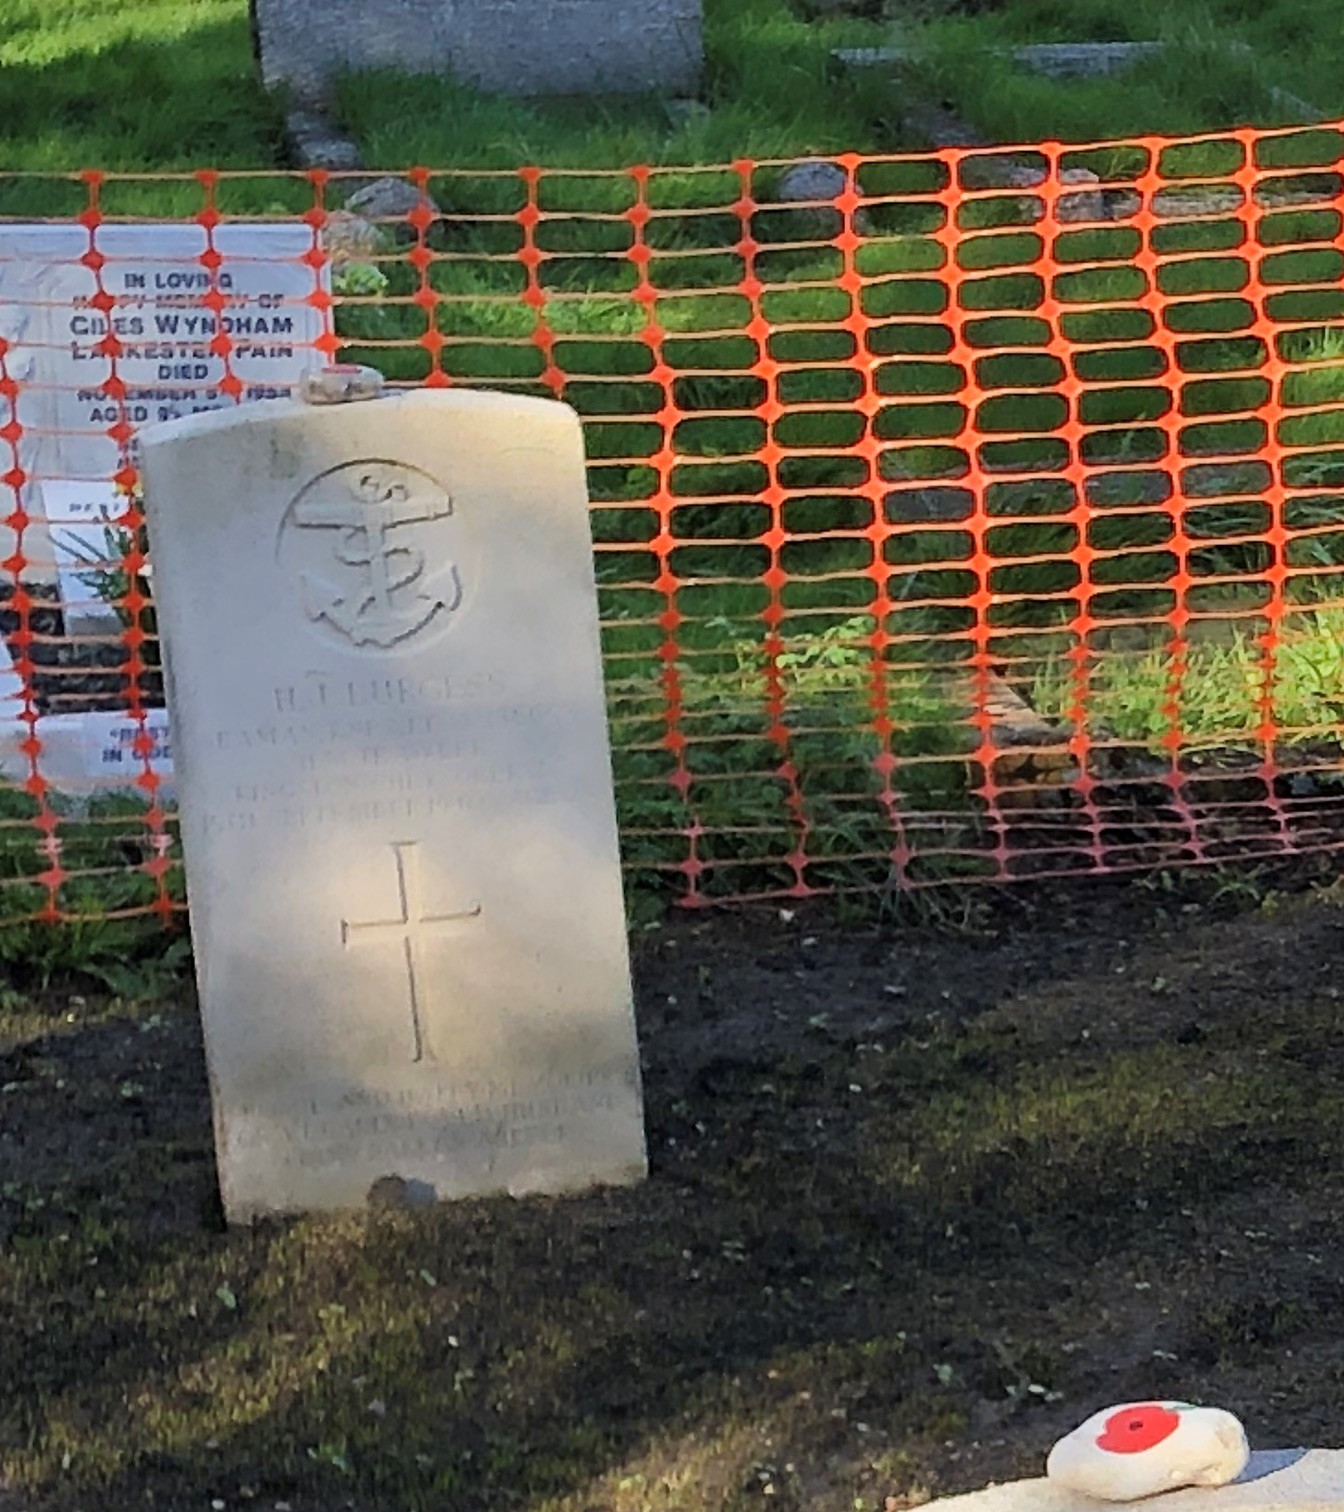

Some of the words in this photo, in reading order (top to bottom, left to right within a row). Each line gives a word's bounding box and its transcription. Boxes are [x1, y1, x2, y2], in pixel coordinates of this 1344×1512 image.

[124, 273, 146, 289] IN
[73, 294, 147, 310] HAPY
[156, 293, 249, 310] MEMOY
[258, 293, 284, 309] OF
[69, 315, 144, 335] GILES
[154, 314, 294, 335] WYNDHAM
[71, 340, 226, 361] LAKESTE
[235, 338, 294, 359] PAIN
[157, 363, 209, 381] DIED
[76, 386, 197, 402] NOEMBER
